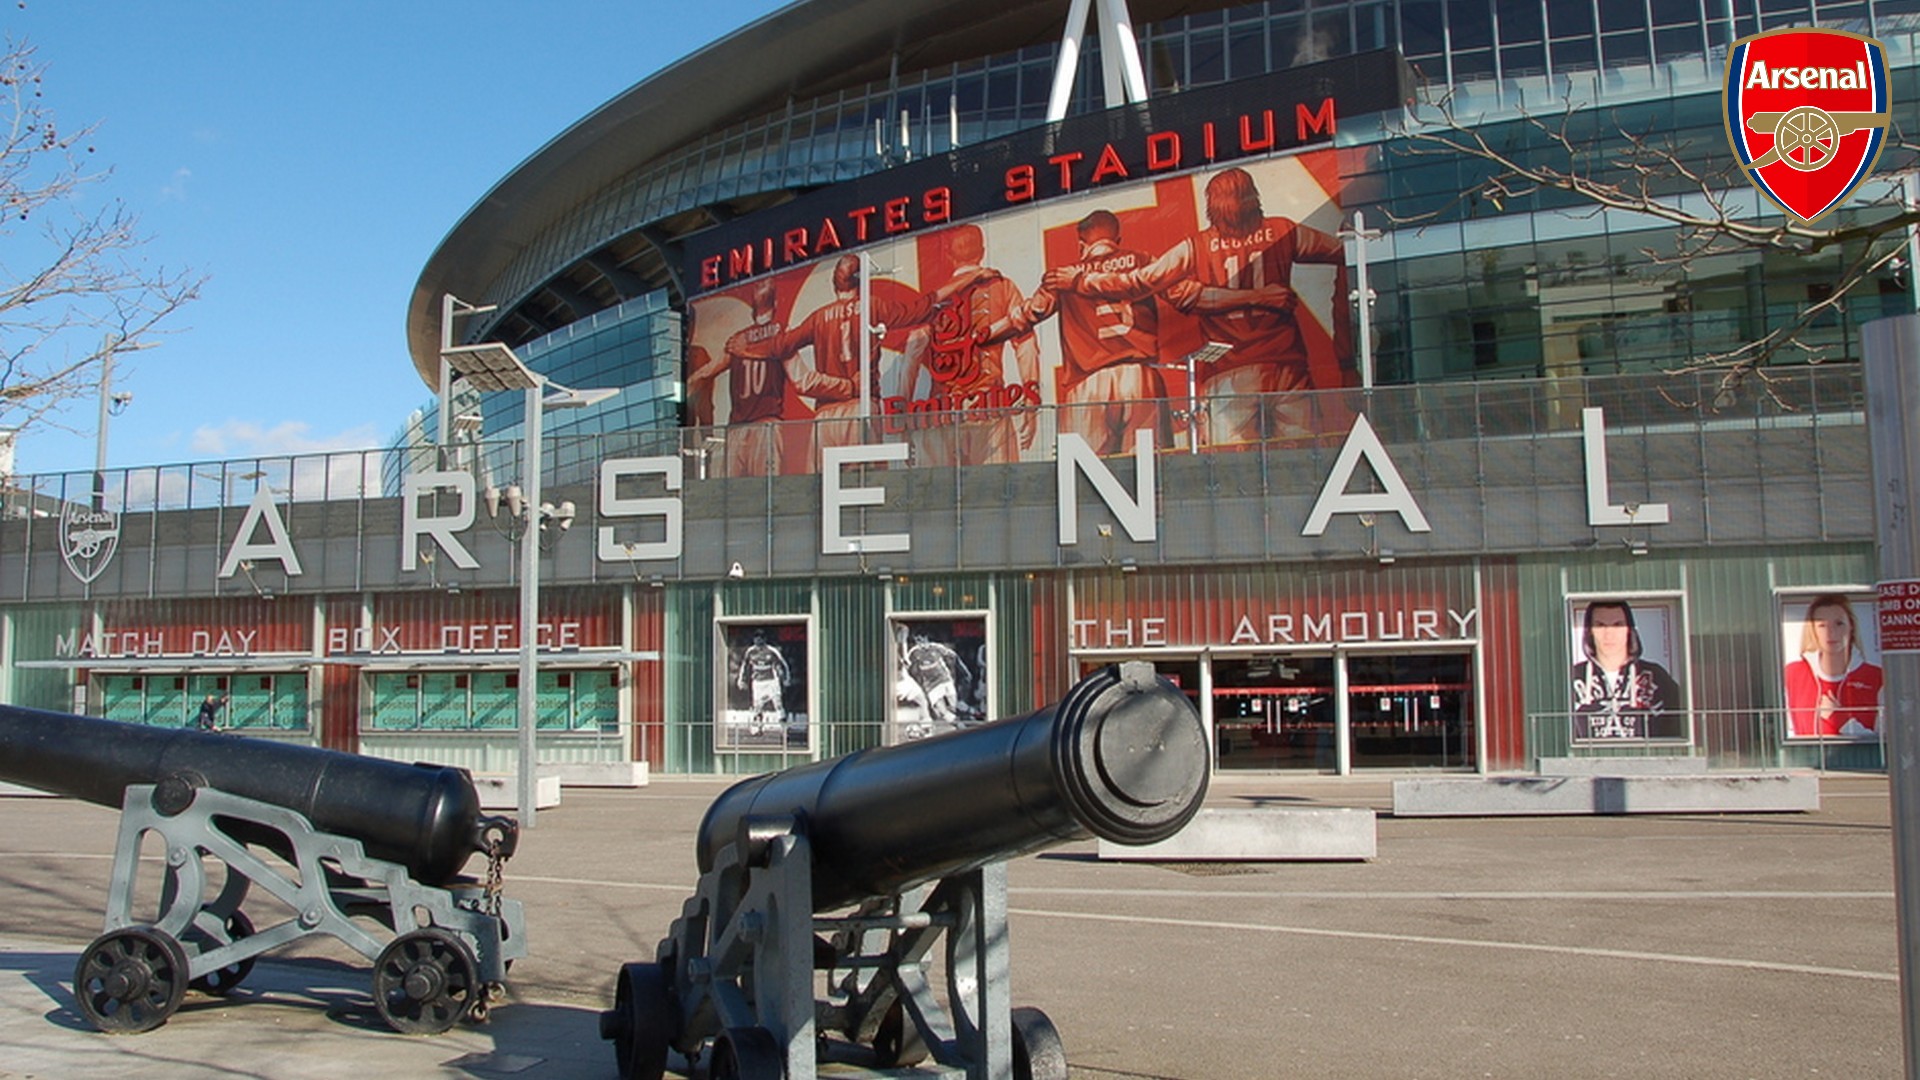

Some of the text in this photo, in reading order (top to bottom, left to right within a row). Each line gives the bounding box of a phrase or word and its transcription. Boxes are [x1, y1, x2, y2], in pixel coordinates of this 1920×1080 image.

[701, 97, 1337, 288] EMIRATES STADIUM
[883, 380, 1042, 434] Emirates
[218, 407, 1671, 579] ARSENAL
[55, 622, 580, 658] MATCH DAY BOX OFFCE
[1073, 608, 1477, 647] THE ARMOURY
